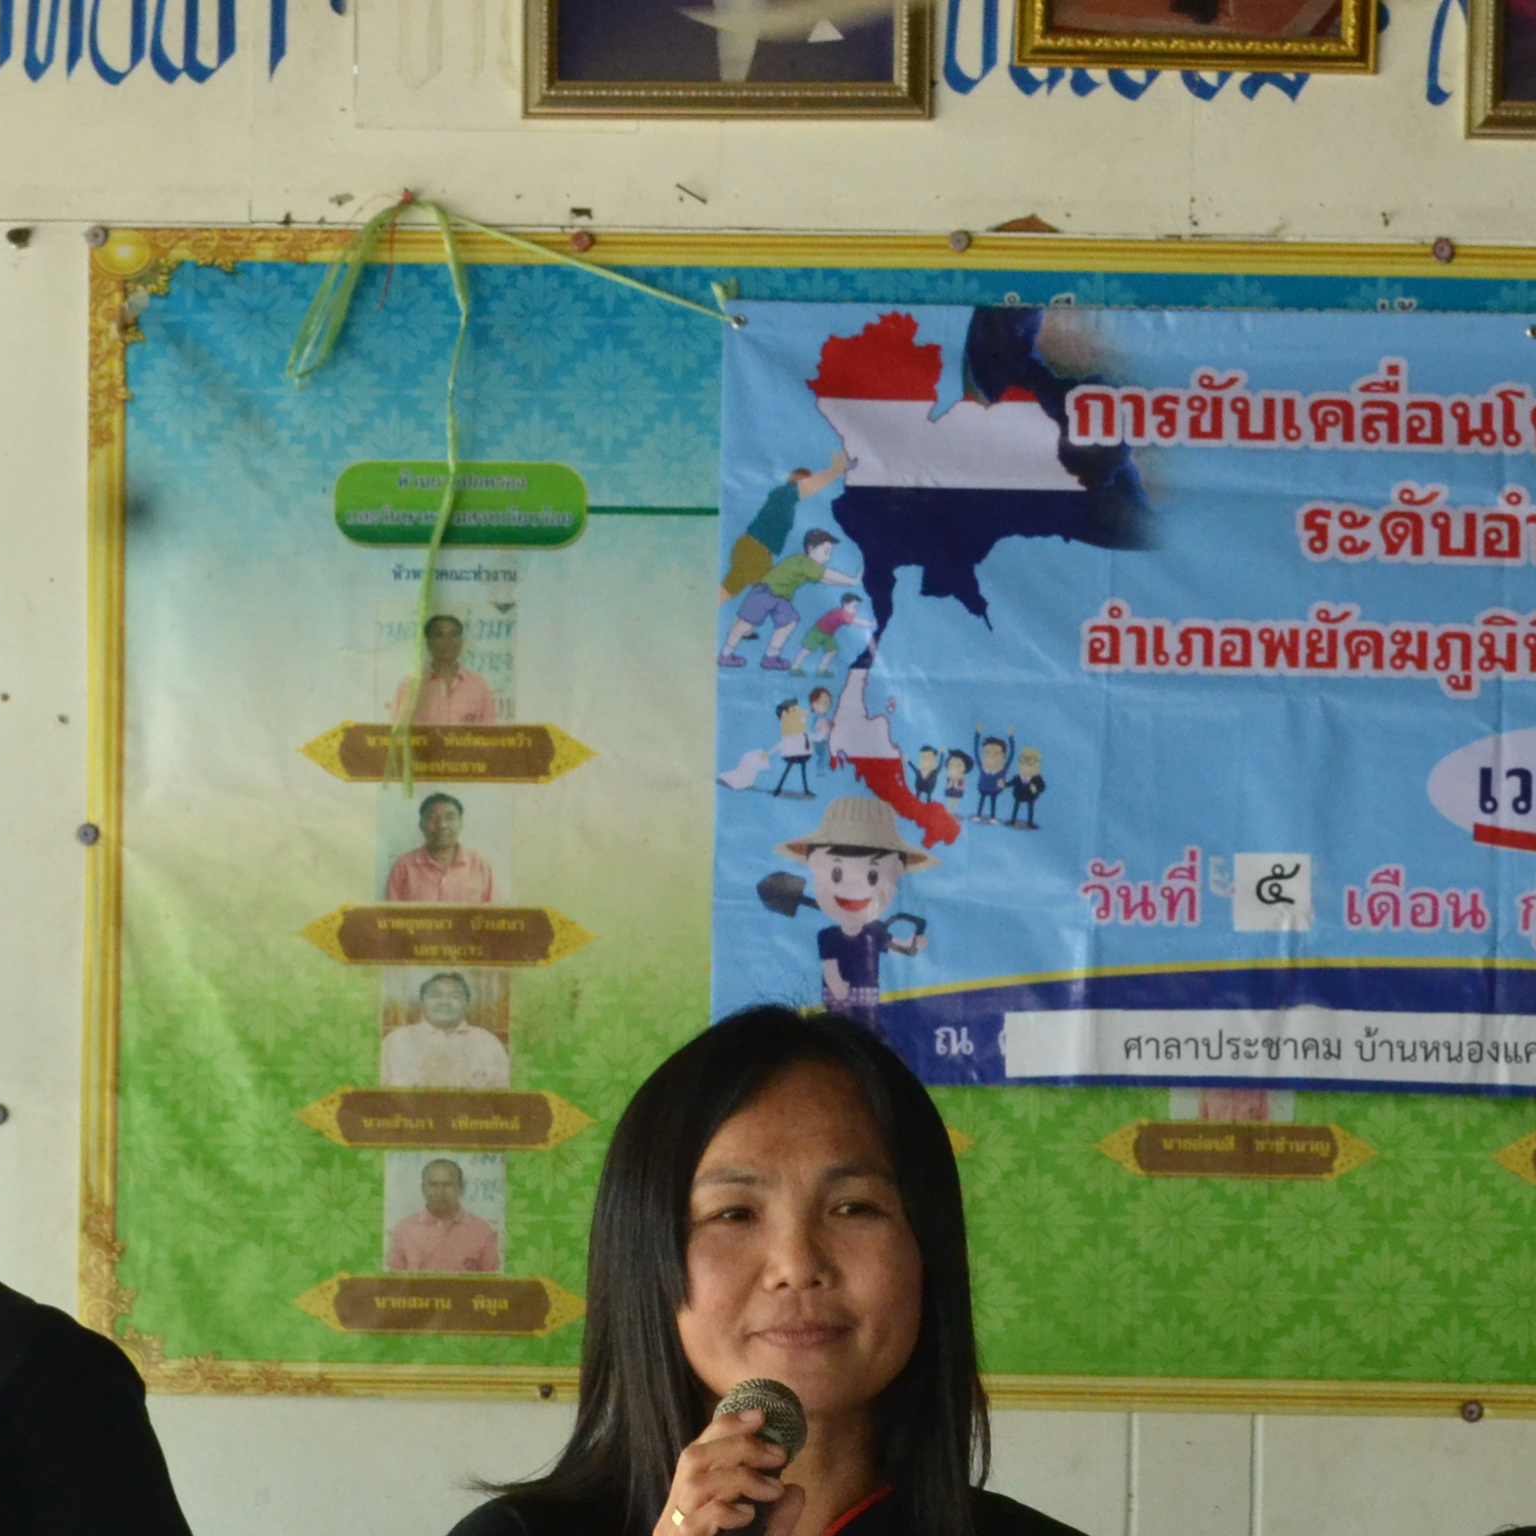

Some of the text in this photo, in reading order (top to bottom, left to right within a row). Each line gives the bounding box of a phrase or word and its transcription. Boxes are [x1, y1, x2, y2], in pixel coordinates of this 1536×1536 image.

[1082, 850, 1199, 924] วันที่
[1256, 863, 1301, 905] ๕
[1346, 869, 1487, 931] เดือน
[1122, 1027, 1343, 1062] ศาลาประชาคม
